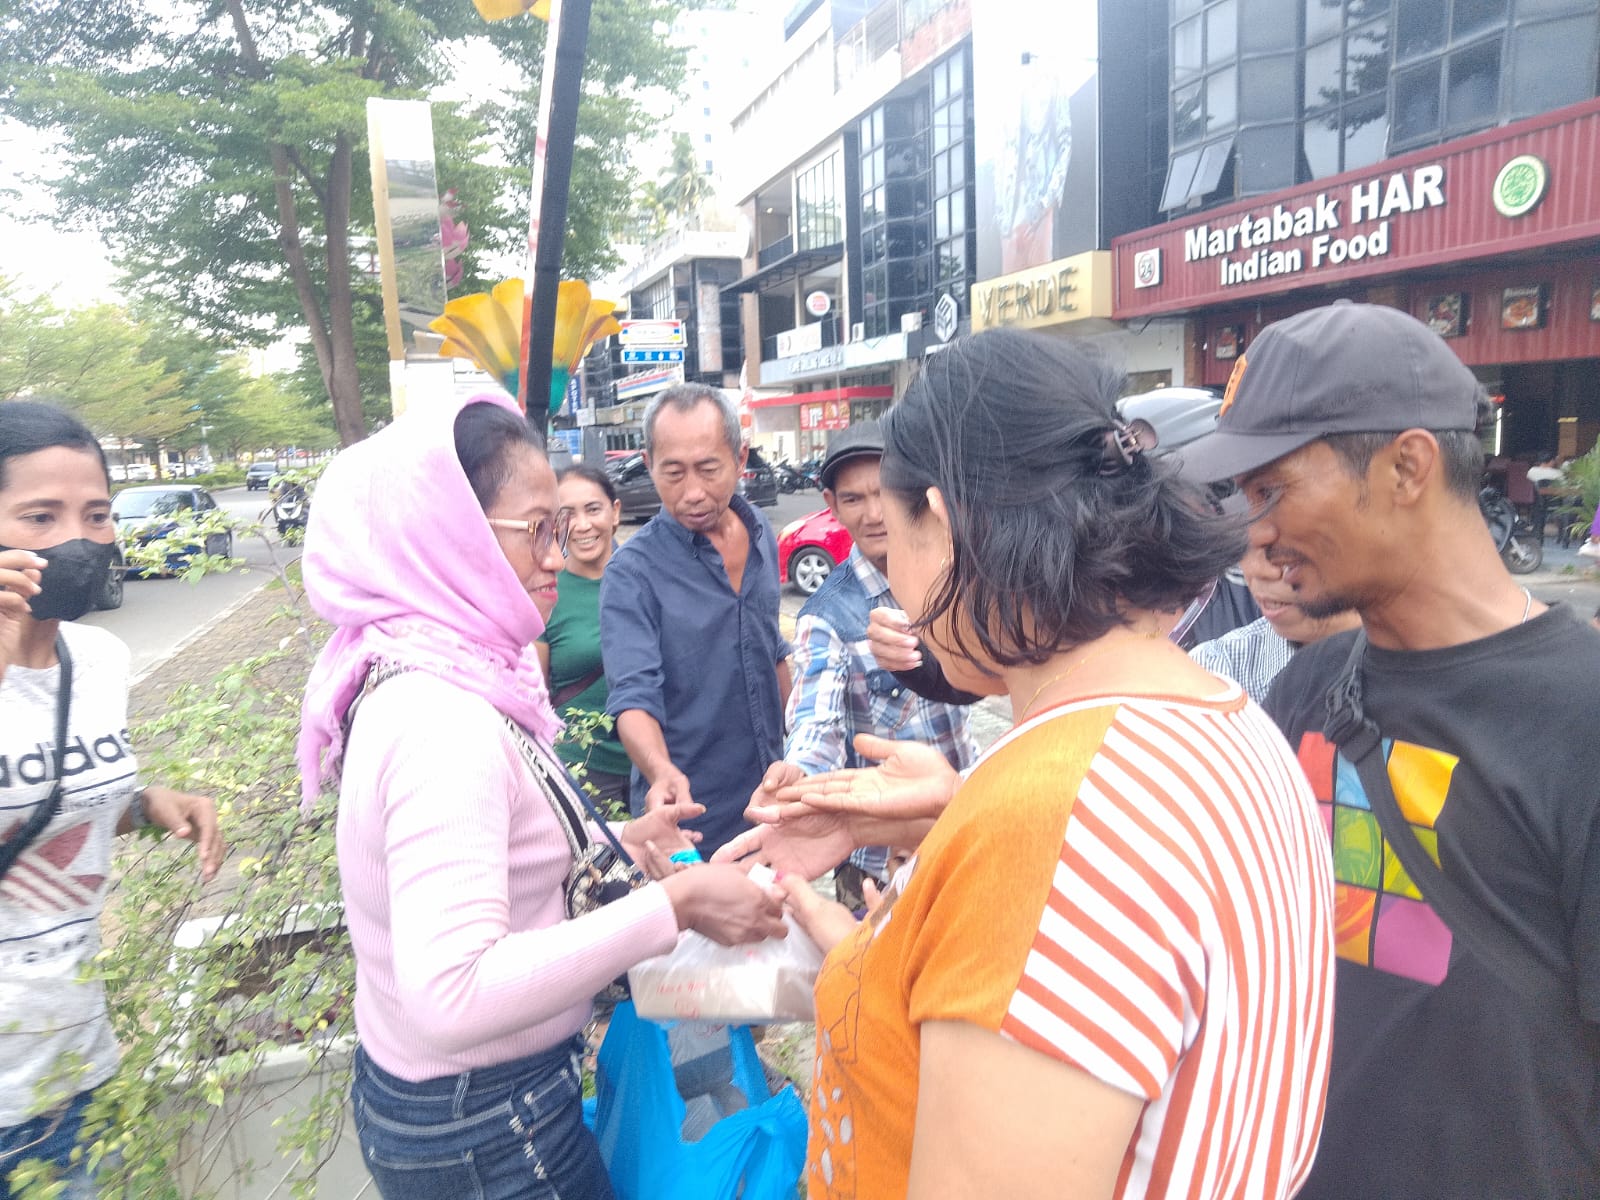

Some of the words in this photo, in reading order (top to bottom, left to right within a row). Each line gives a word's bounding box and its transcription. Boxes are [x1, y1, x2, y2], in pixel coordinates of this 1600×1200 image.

[1184, 193, 1340, 263] Martabak
[1351, 164, 1445, 225] HAR
[1220, 248, 1303, 286] Indian
[1311, 221, 1390, 268] Food
[977, 266, 1079, 326] VERDE
[0, 727, 131, 788] dda
